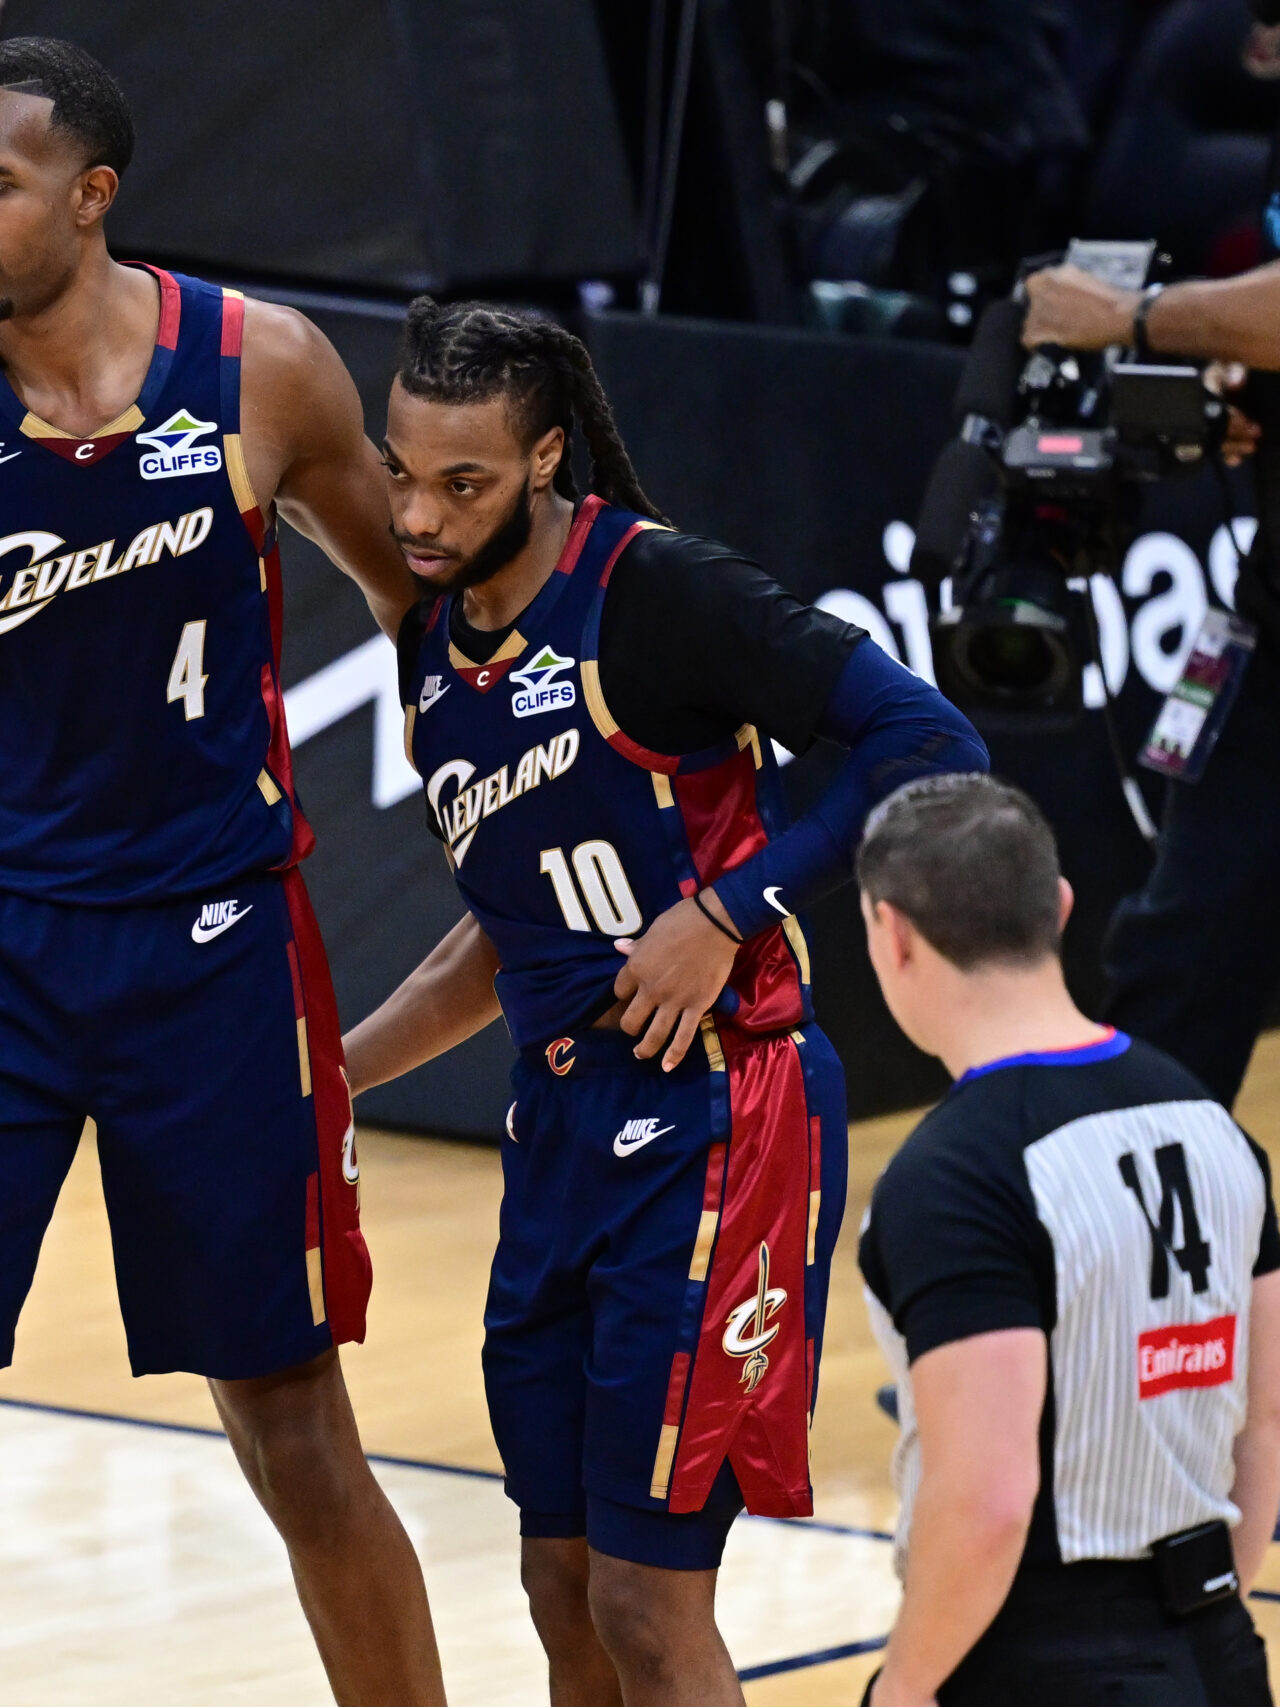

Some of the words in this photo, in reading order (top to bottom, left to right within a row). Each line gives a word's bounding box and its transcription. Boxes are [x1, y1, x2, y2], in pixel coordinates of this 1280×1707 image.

[74, 443, 95, 460] C
[143, 451, 219, 474] CLIFFS
[166, 619, 210, 722] 4
[476, 670, 491, 687] C
[515, 686, 574, 712] CLIFFS
[427, 728, 580, 870] CLEVELAND
[539, 839, 644, 937] 10
[200, 899, 238, 927] NIKE
[545, 1037, 576, 1076] C
[620, 1118, 660, 1141] NIKE
[1118, 1142, 1211, 1300] 14
